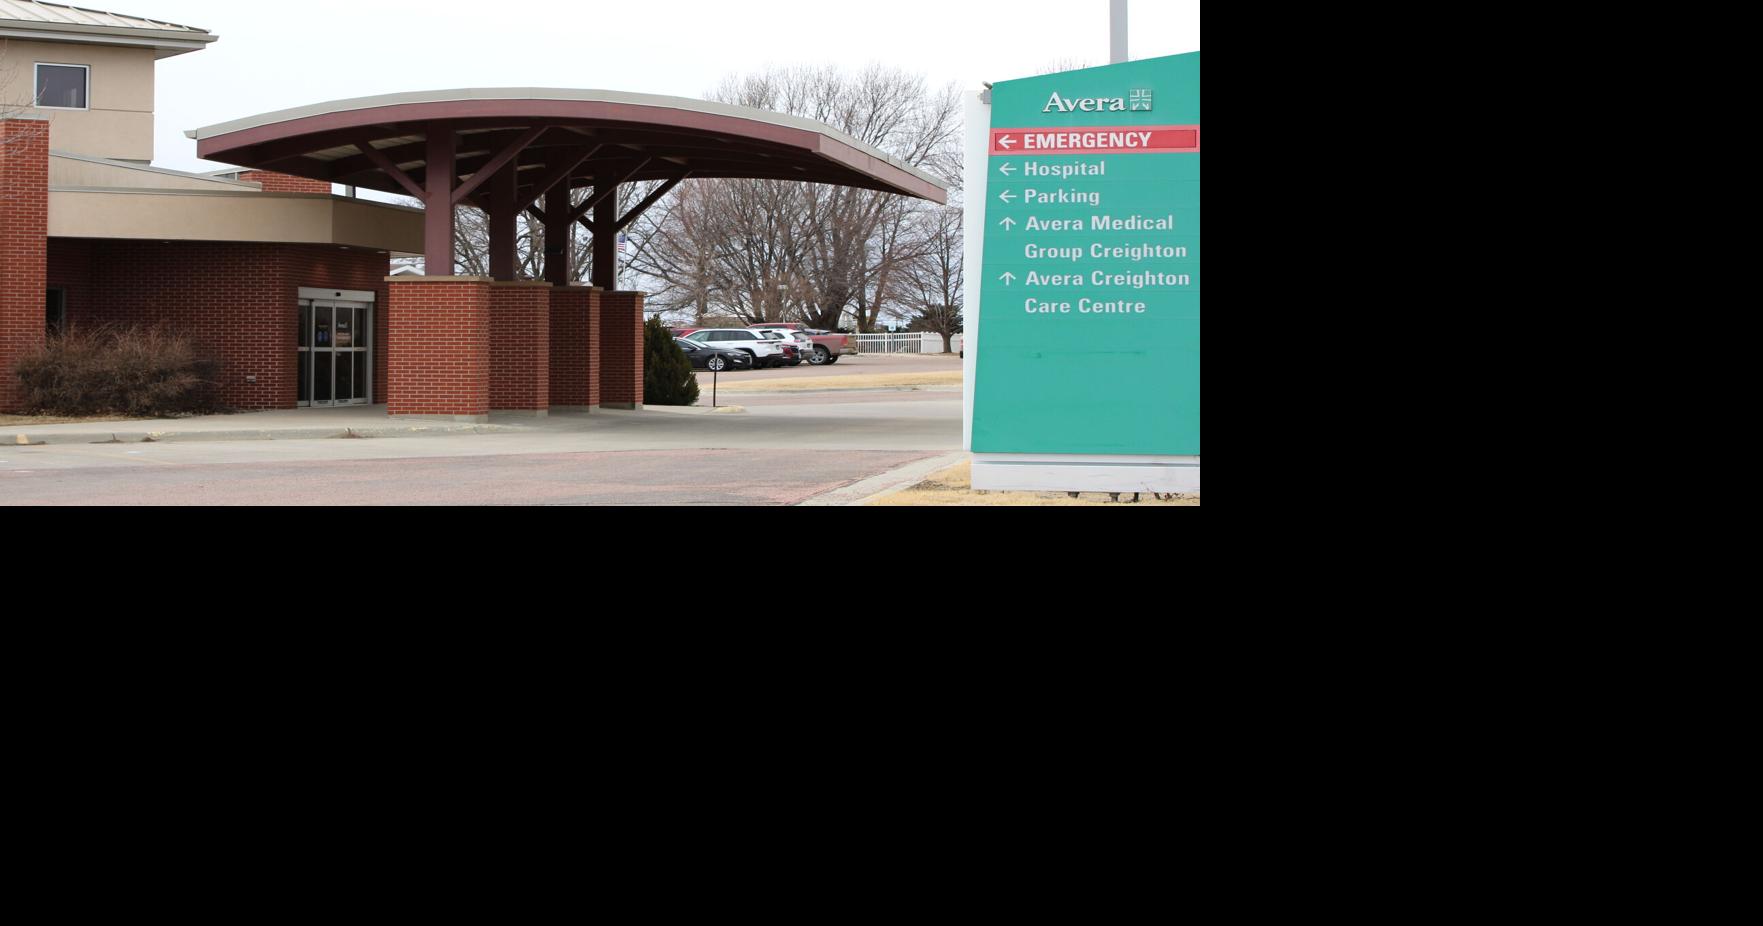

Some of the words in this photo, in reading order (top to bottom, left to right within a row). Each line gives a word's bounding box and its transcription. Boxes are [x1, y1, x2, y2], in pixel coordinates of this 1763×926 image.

[1041, 91, 1126, 112] Avera
[1023, 131, 1152, 149] EMERGENCY
[1024, 160, 1106, 179] Hospital
[1024, 188, 1100, 206] Parking
[1025, 216, 1083, 231] Avera
[1091, 215, 1173, 230] Medical
[1025, 243, 1083, 261] Group
[1090, 243, 1187, 261] Creighton
[1025, 271, 1083, 286] Avera
[1091, 270, 1190, 289] Creighton
[1025, 298, 1071, 313] Care
[1078, 298, 1146, 313] Centre
